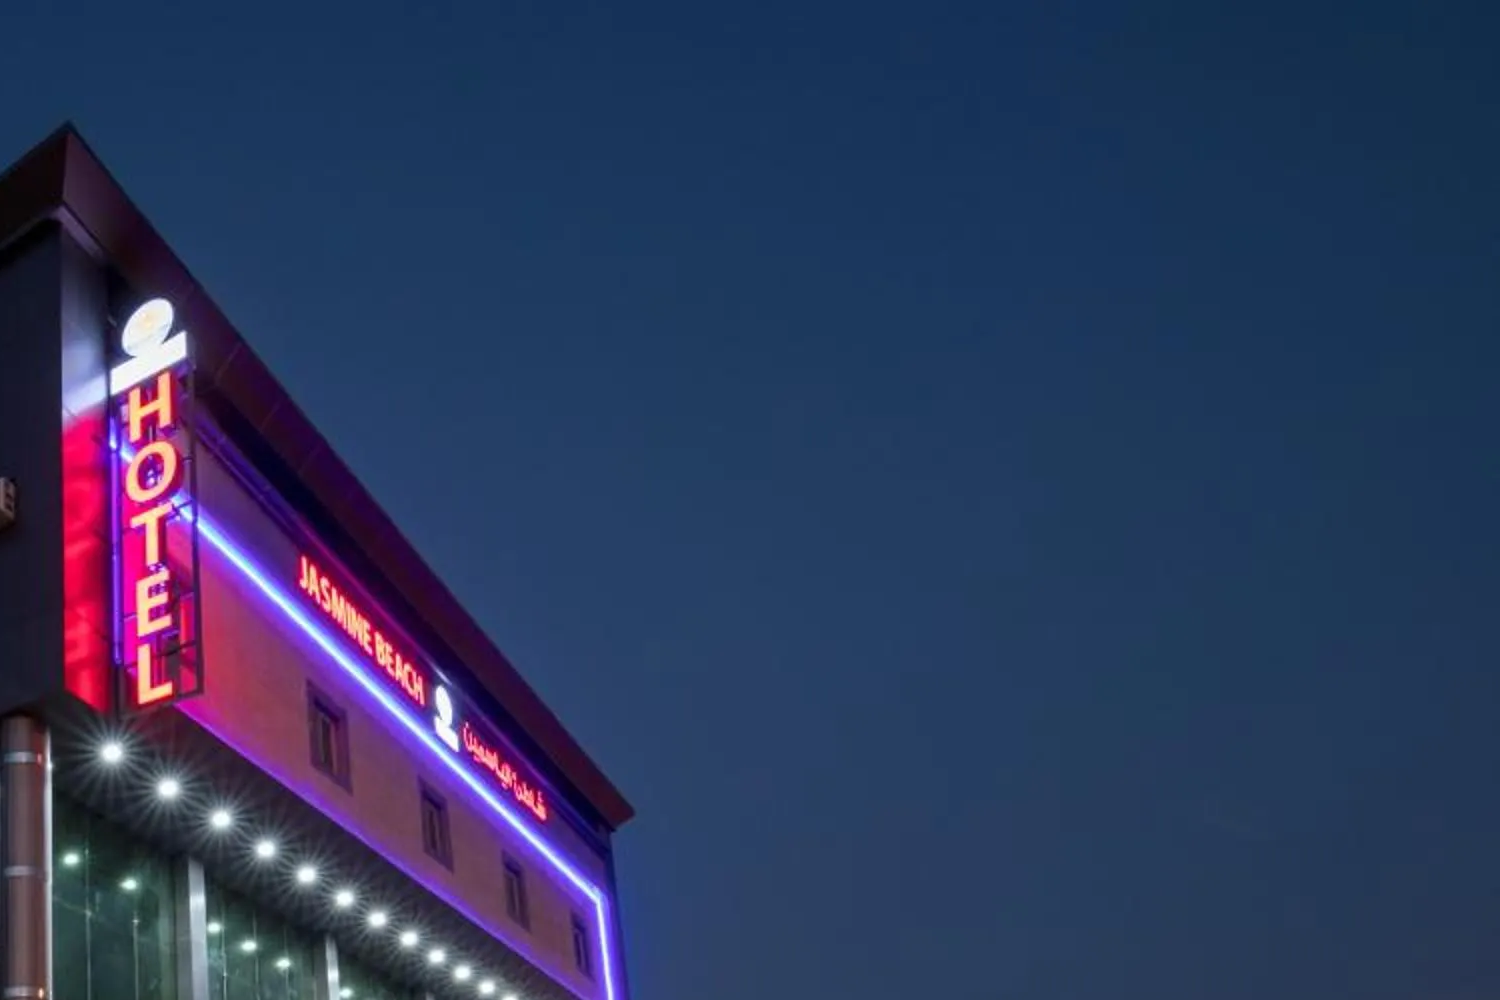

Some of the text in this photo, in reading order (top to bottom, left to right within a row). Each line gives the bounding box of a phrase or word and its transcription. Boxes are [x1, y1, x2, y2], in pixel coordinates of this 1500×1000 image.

[124, 373, 178, 705] HOTEL
[299, 555, 426, 707] JASMINE BEACH
